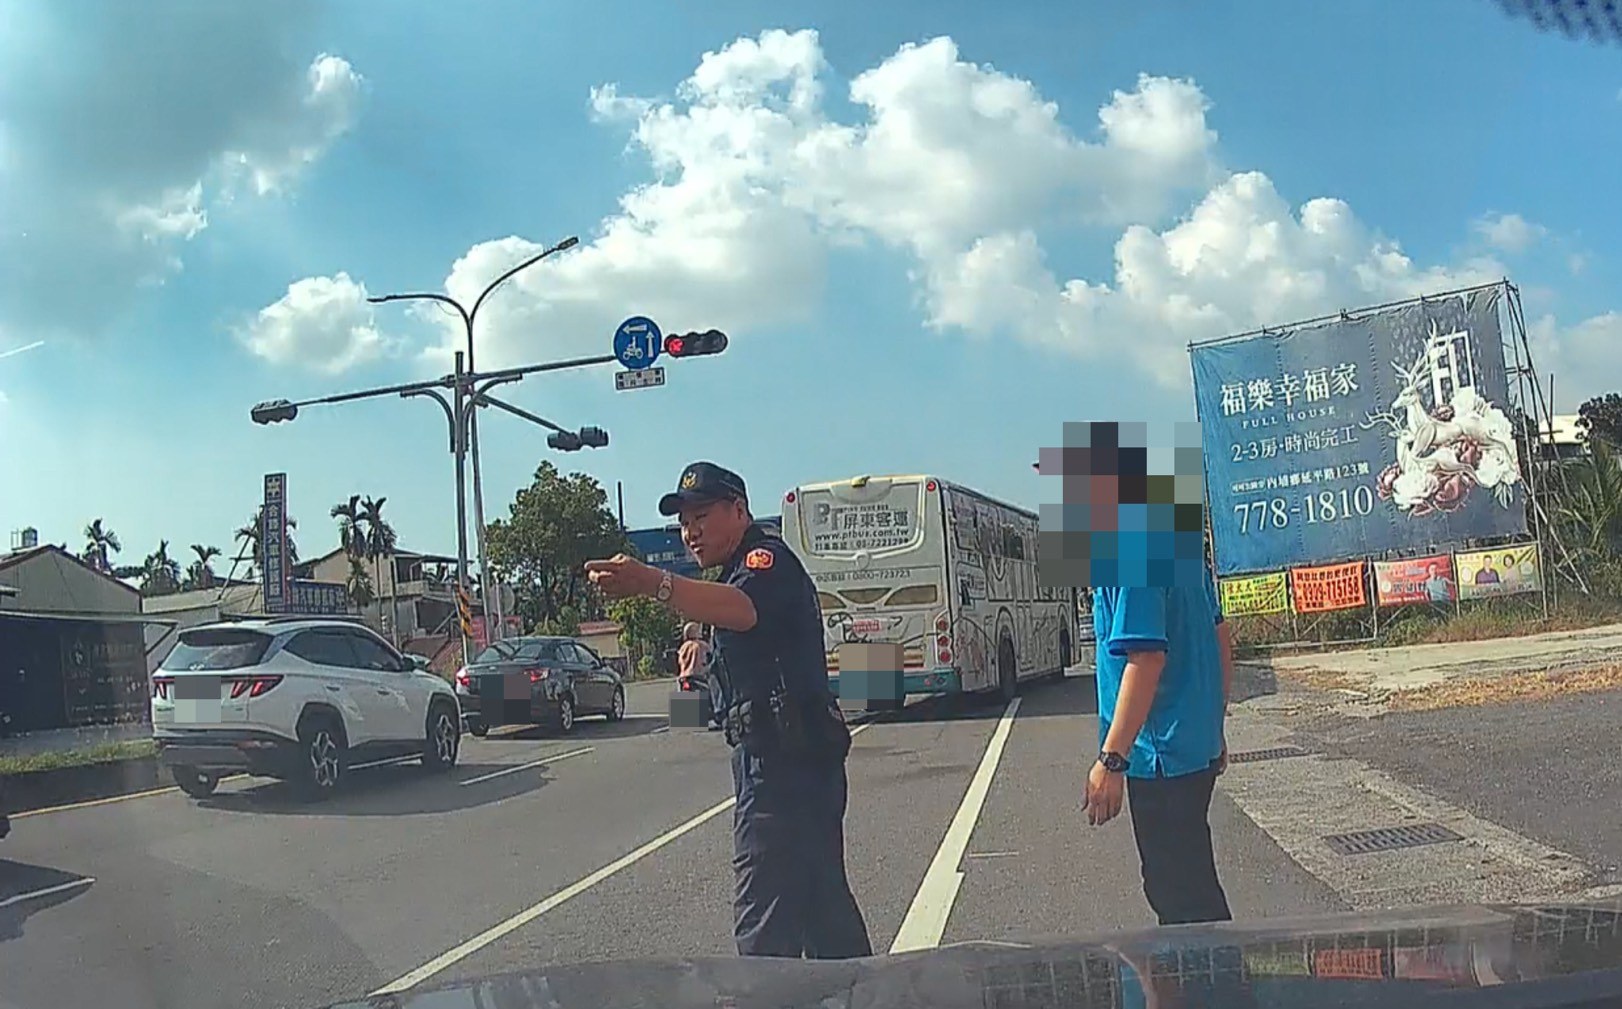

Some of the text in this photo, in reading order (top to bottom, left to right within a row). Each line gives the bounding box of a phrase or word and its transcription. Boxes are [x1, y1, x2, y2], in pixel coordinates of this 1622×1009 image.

[1220, 363, 1359, 416] 福樂幸福家
[1242, 405, 1336, 429] FULL HOUSE
[844, 511, 908, 529] 屏東客運
[1233, 485, 1374, 534] 778-1810
[815, 528, 909, 541] www.ptbus.com.tw
